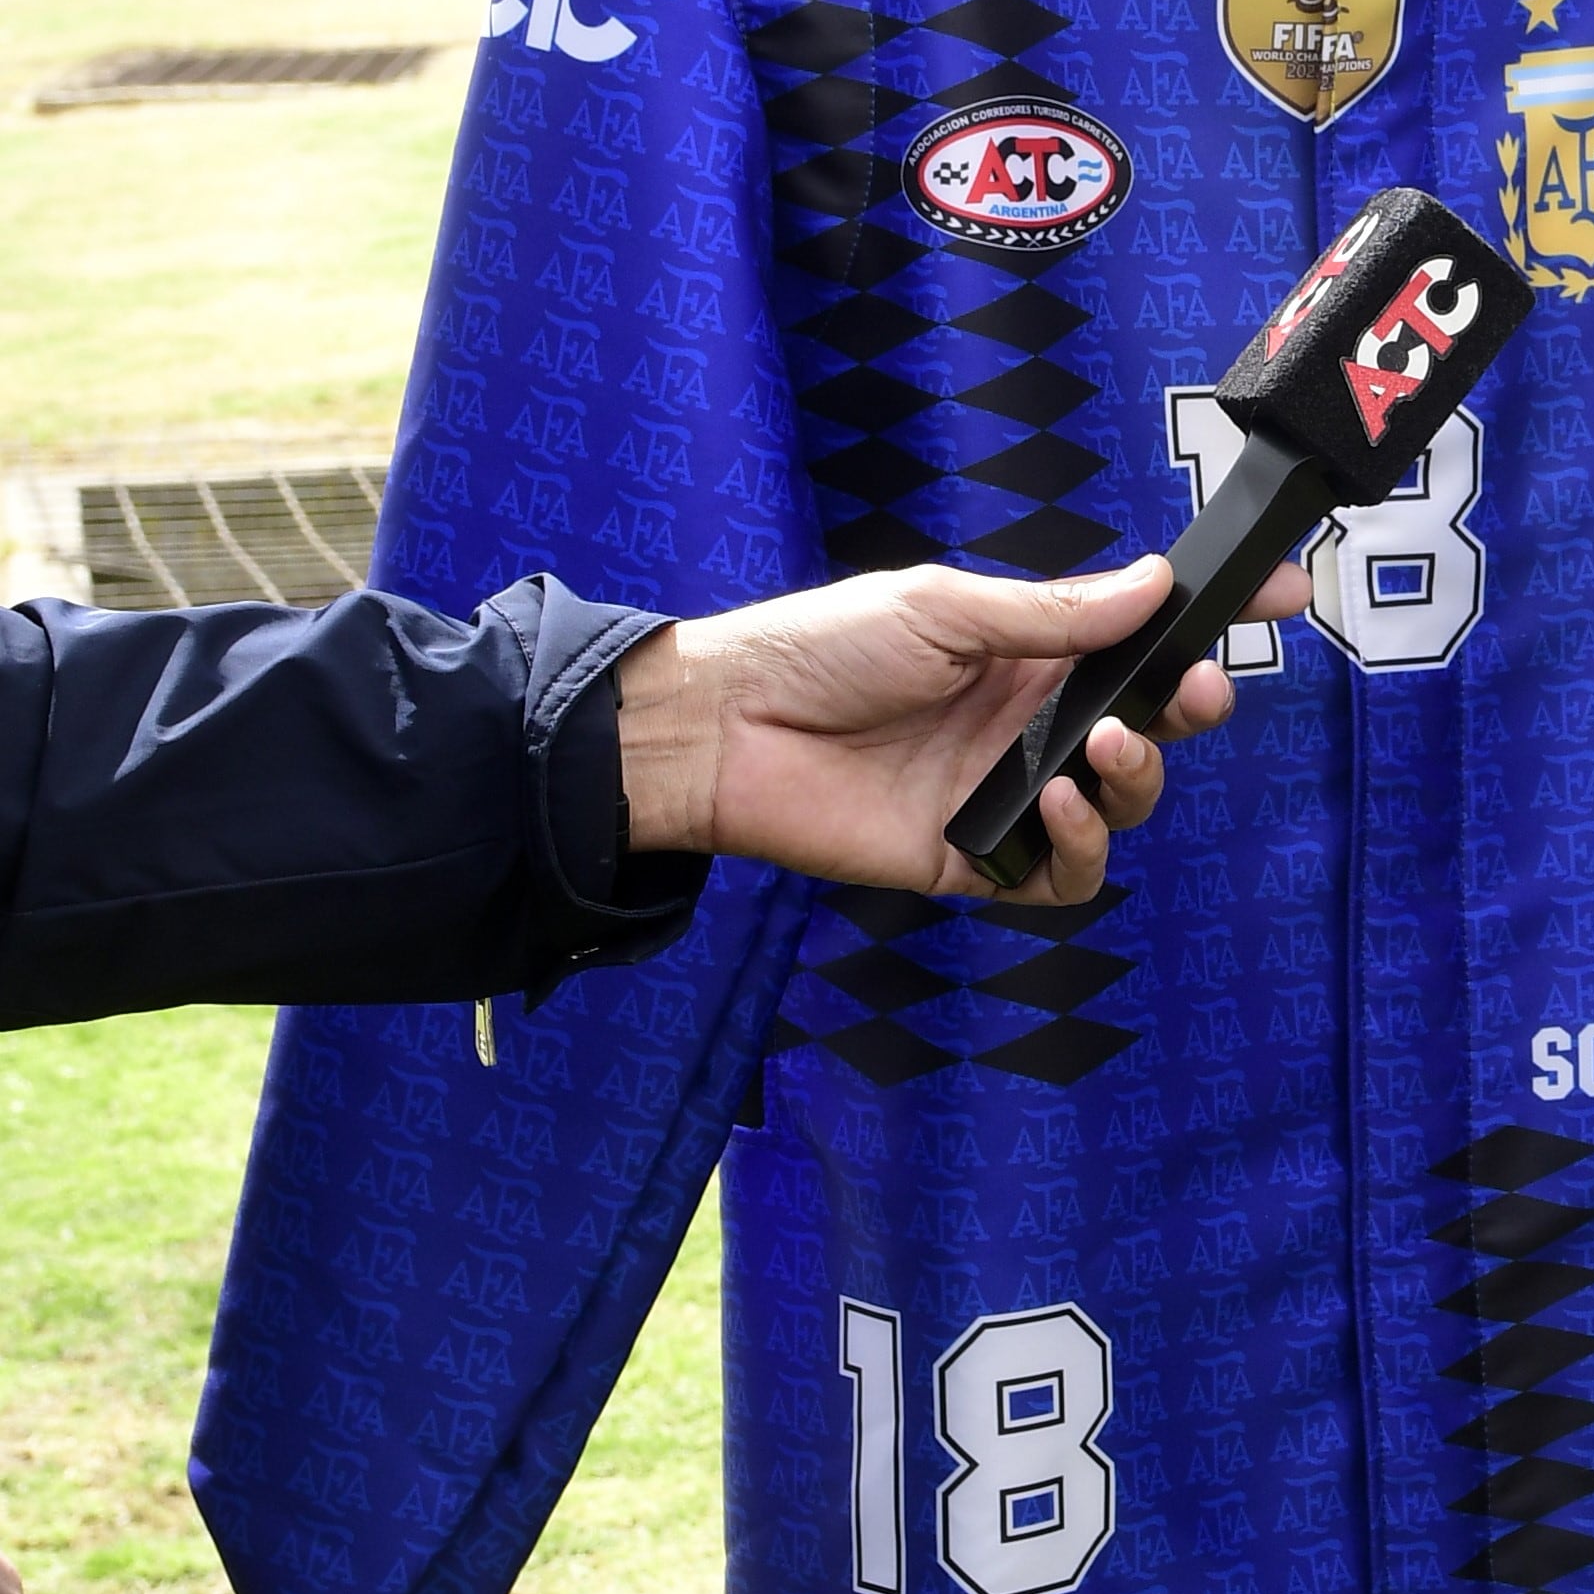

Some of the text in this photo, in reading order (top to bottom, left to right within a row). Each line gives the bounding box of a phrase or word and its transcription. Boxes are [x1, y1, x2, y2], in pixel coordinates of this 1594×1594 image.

[1112, 51, 1194, 109] AFA
[1251, 49, 1294, 62] WORLD
[560, 83, 648, 151] AFA
[908, 104, 1123, 167] ASOCIACION CORREDORES TURISMO CARRETERA
[965, 135, 1078, 205] ACTC
[1214, 124, 1296, 182] AFA
[545, 159, 633, 227] AFA
[988, 202, 1069, 218] ARGENTINA
[1219, 197, 1301, 255] AFA
[1120, 199, 1202, 257] AFA
[531, 235, 619, 303] AFA
[629, 257, 729, 335] AFA
[1127, 273, 1209, 331] AFA
[517, 311, 605, 379] AFA
[1341, 256, 1480, 445] ACTC
[502, 387, 590, 455] AFA
[599, 410, 699, 488] AFA
[488, 463, 576, 531] AFA
[591, 491, 679, 559] AFA
[1248, 842, 1330, 900] AFA
[1258, 981, 1339, 1047] AFA
[355, 1061, 455, 1139] AFA
[1355, 1052, 1430, 1115] AFA
[1011, 1103, 1086, 1166] AFA
[1358, 1122, 1433, 1185] AFA
[339, 1136, 439, 1214] AFA
[1012, 1176, 1087, 1239] AFA
[323, 1211, 423, 1289] AFA
[433, 1238, 533, 1316] AFA
[1270, 1466, 1349, 1535] AFA
